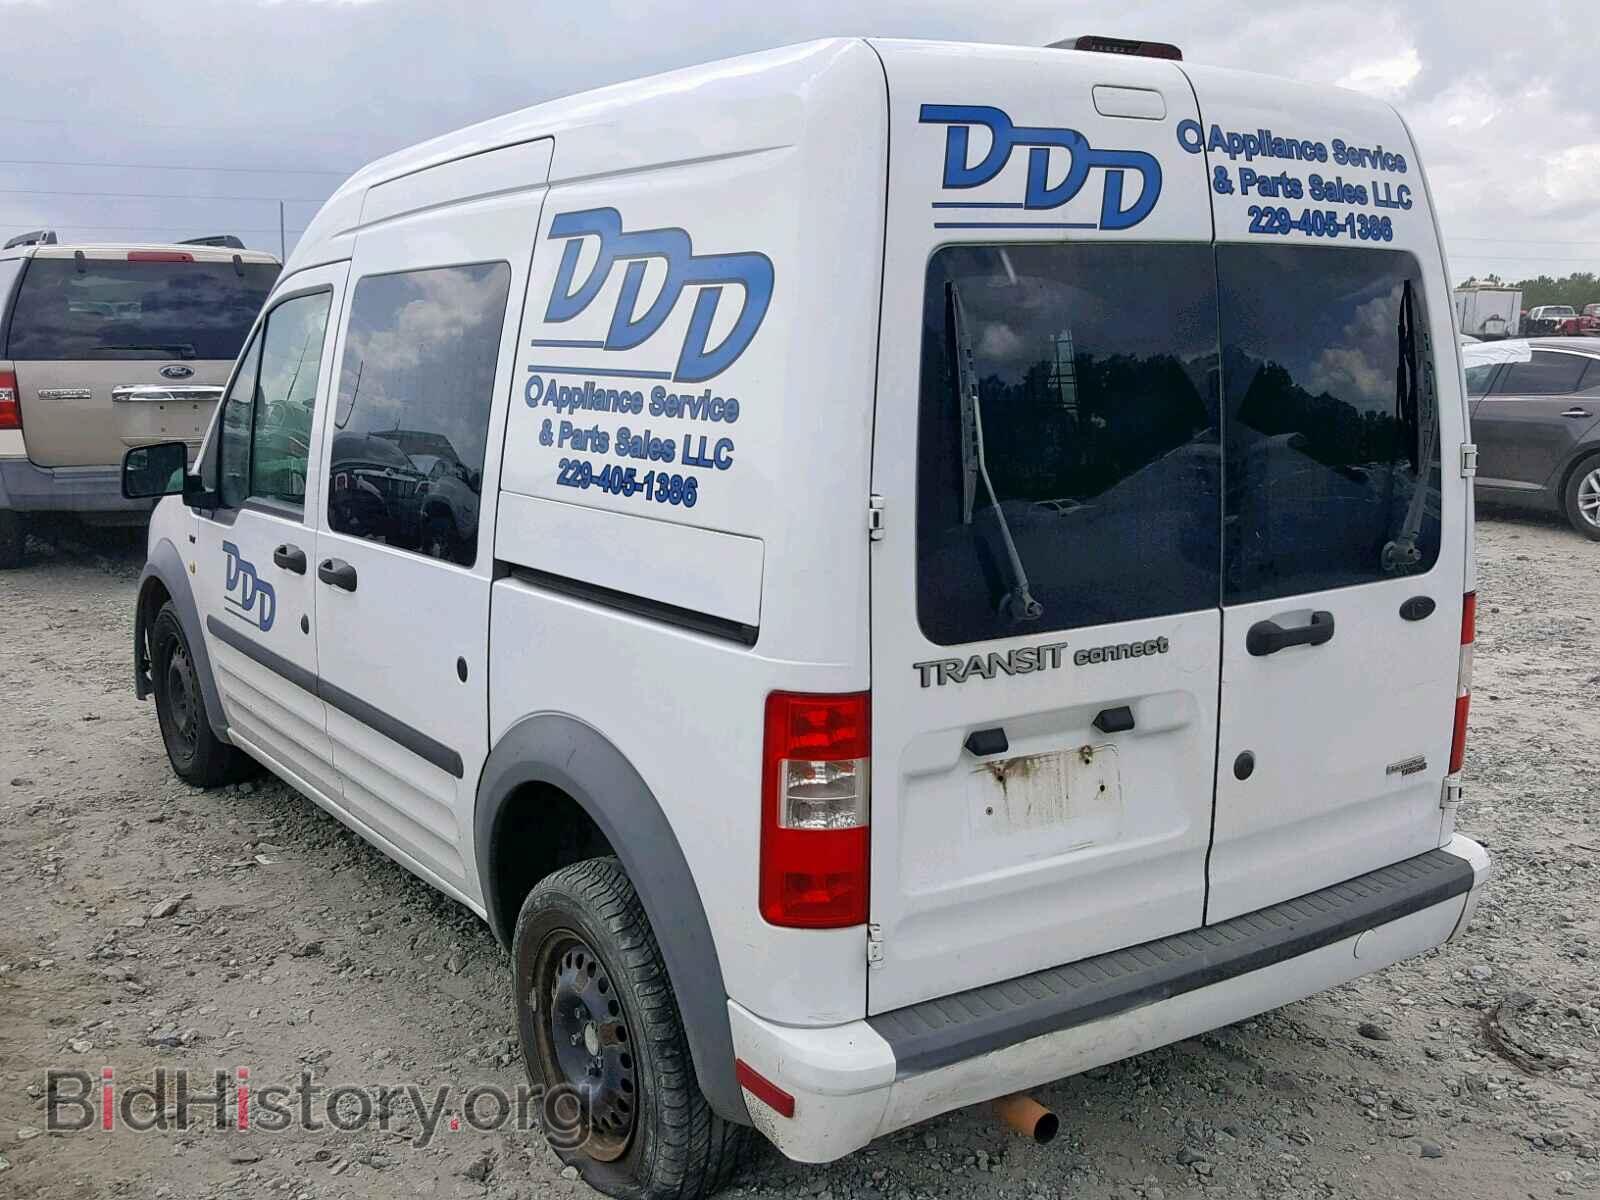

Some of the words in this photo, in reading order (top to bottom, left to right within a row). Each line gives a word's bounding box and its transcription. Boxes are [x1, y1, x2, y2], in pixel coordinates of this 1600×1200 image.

[918, 104, 1162, 230] DDD
[1332, 139, 1407, 173] Service
[1213, 166, 1235, 195] &
[1239, 167, 1303, 200] Parts
[1308, 174, 1368, 205] Sales
[1372, 181, 1413, 210] LLC
[1248, 205, 1393, 242] 229-405-1386
[544, 207, 775, 383] DDD
[649, 385, 739, 424] Service
[539, 418, 554, 448] &
[558, 420, 610, 454] Parts
[615, 426, 676, 463] Sales
[682, 434, 735, 471] LLC
[557, 458, 698, 508] 229-405-1386
[222, 540, 276, 632] DDD
[913, 642, 1067, 688] TRANSIT
[1074, 636, 1168, 666] connect
